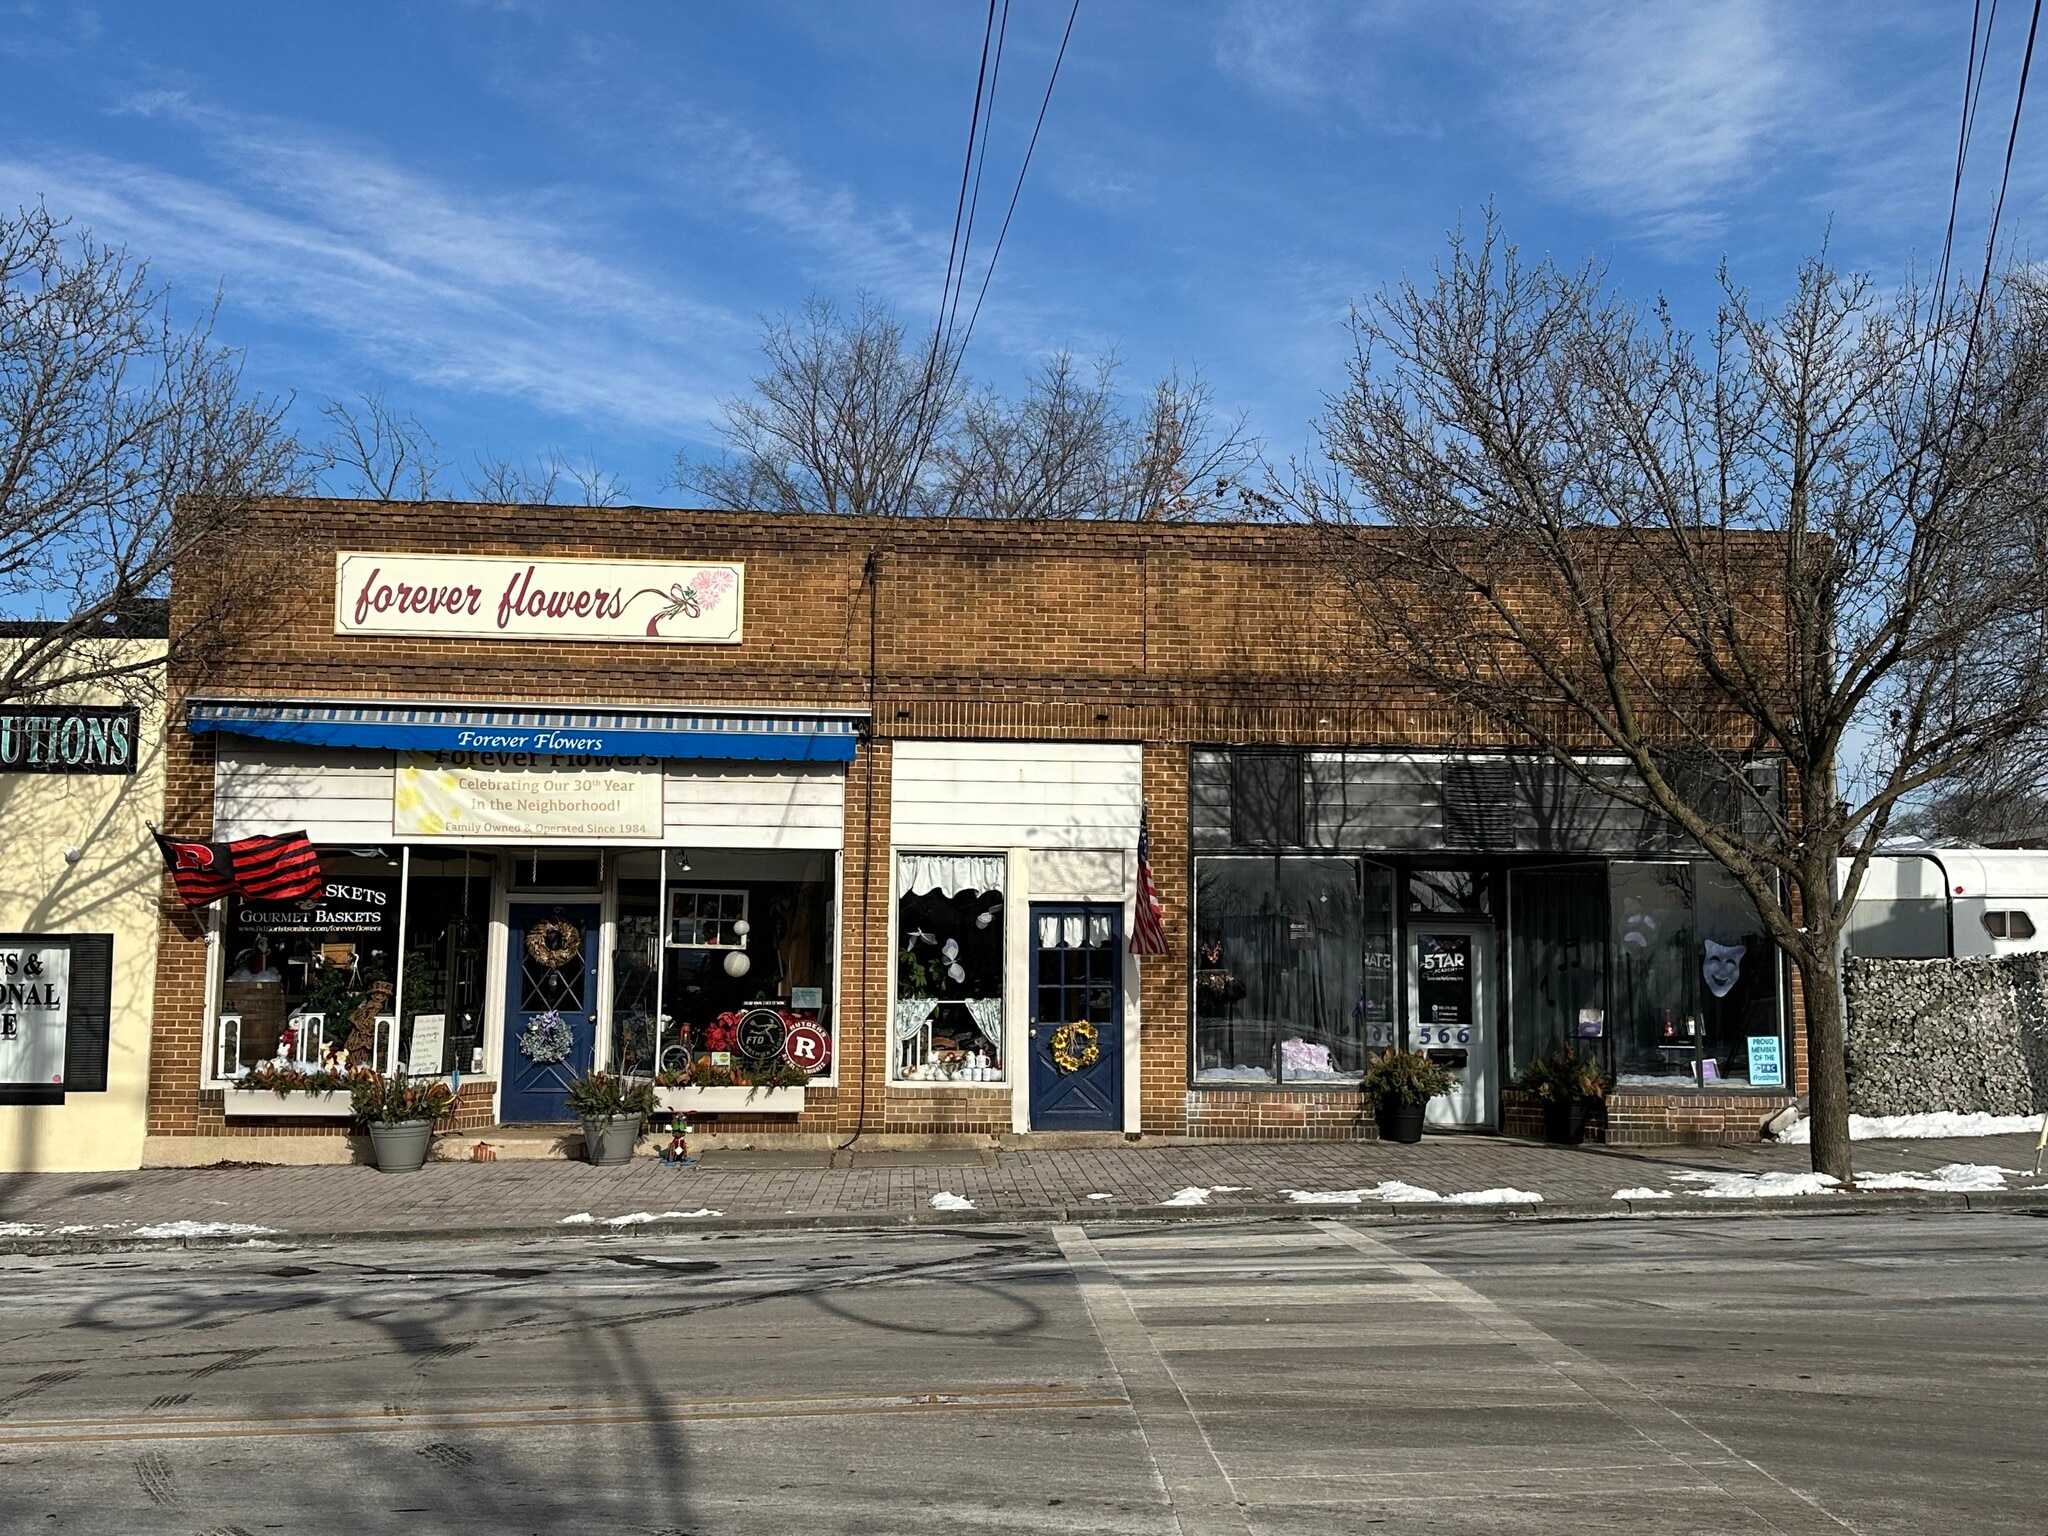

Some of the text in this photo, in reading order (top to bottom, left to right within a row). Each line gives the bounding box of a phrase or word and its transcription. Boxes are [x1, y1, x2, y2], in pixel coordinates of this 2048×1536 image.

[355, 566, 623, 629] forever flowers
[457, 730, 603, 751] Forever Flowers
[434, 750, 538, 767] Forever
[458, 778, 635, 794] Celebrating Our 30th Year
[490, 798, 513, 811] the
[516, 798, 621, 815] Neighborhood!
[445, 822, 647, 835] Family Owned & Operated Since 1984
[323, 883, 387, 905] SKETS
[239, 909, 382, 923] GOURMET BASKETS
[23, 953, 44, 976] &
[789, 1021, 827, 1038] RUTGERS
[745, 1036, 765, 1045] FTD
[794, 1036, 816, 1060] R
